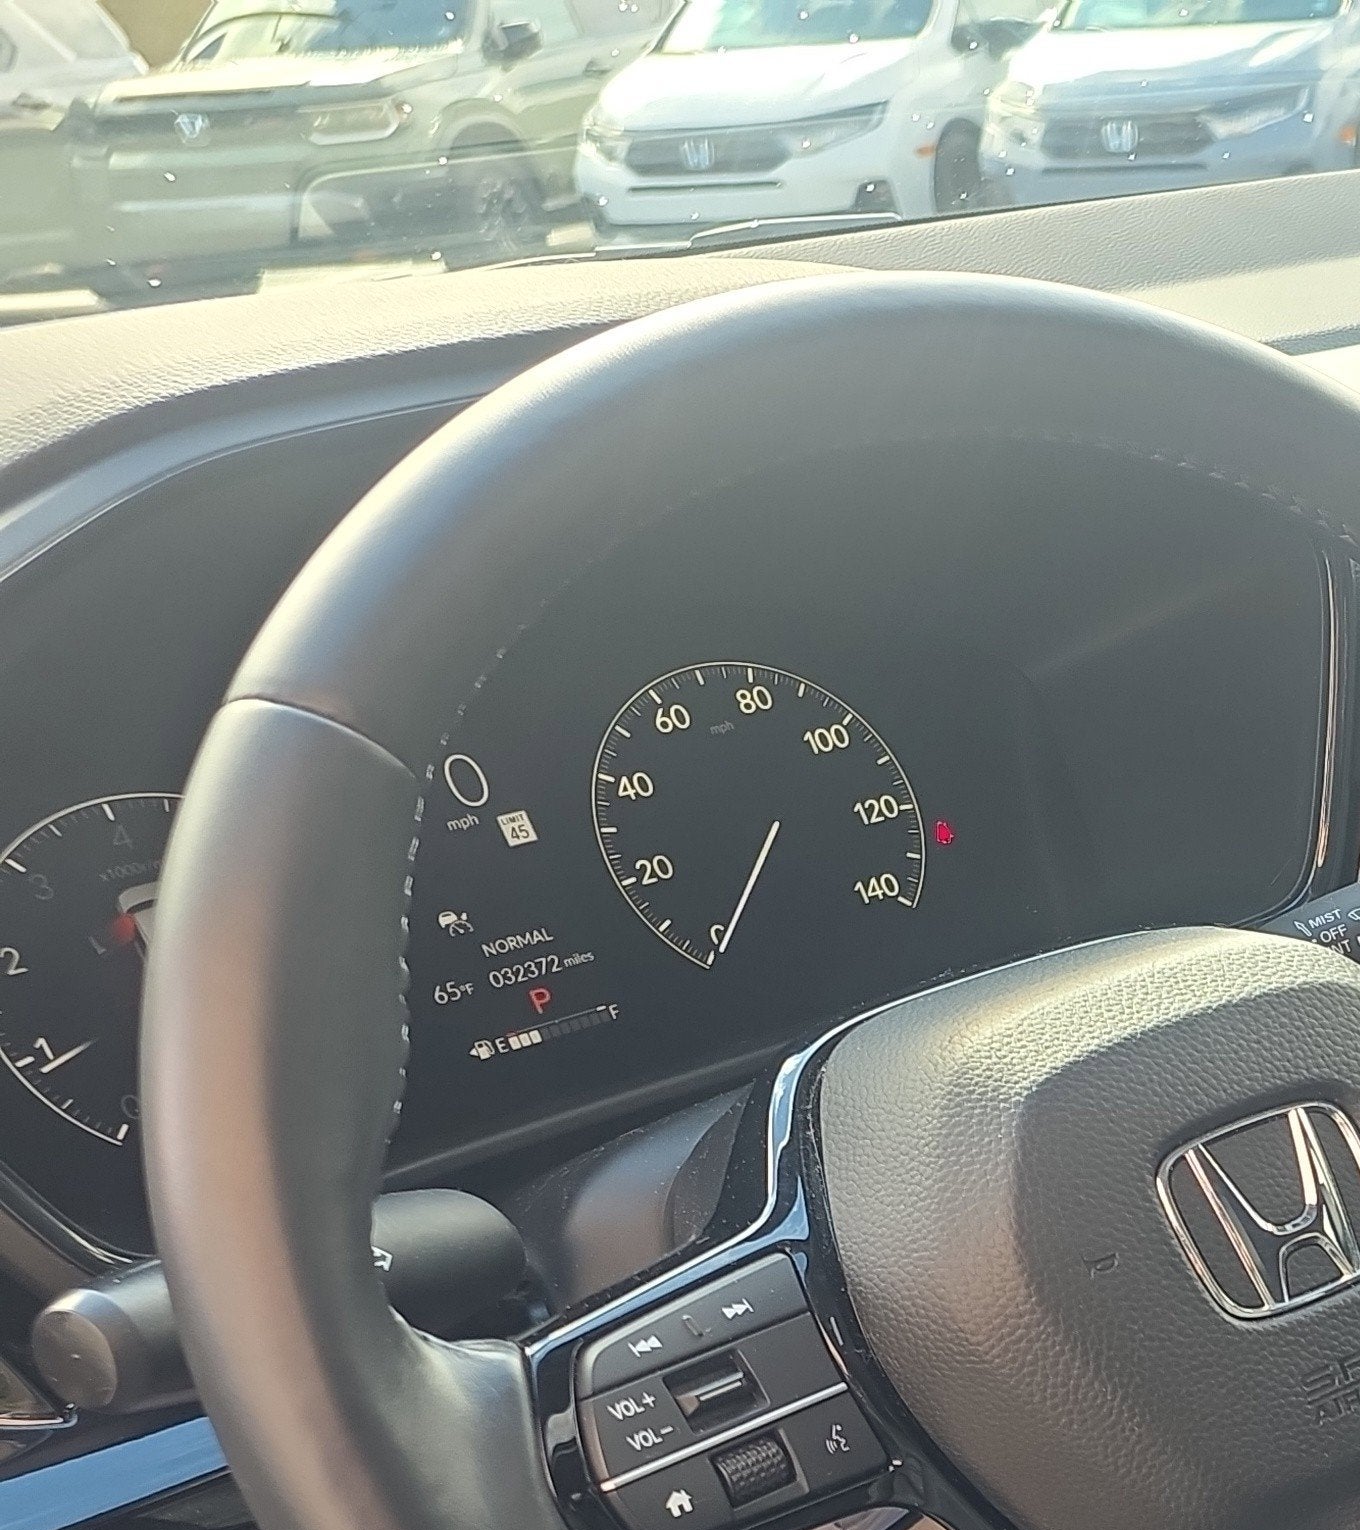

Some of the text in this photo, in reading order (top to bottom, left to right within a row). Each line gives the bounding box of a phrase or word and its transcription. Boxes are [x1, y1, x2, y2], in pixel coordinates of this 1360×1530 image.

[735, 685, 773, 714] 80
[655, 704, 691, 733] 60
[710, 720, 735, 735] mph
[803, 724, 849, 754] 100
[444, 754, 489, 807] 0
[617, 772, 654, 800] 40
[446, 813, 480, 831] mph
[500, 813, 525, 826] LIMIT
[853, 795, 899, 825] 120
[510, 824, 530, 840] 45
[635, 855, 673, 885] 20
[853, 873, 900, 904] 140
[1308, 908, 1342, 929] MIST
[481, 928, 554, 958] NORMAL
[1319, 924, 1348, 944] OFF
[0, 947, 28, 975] 2
[489, 951, 595, 988] 032372 miles
[529, 988, 551, 1014] P
[608, 1003, 620, 1020] F
[495, 1037, 510, 1053] E
[607, 1392, 656, 1421] VOL+
